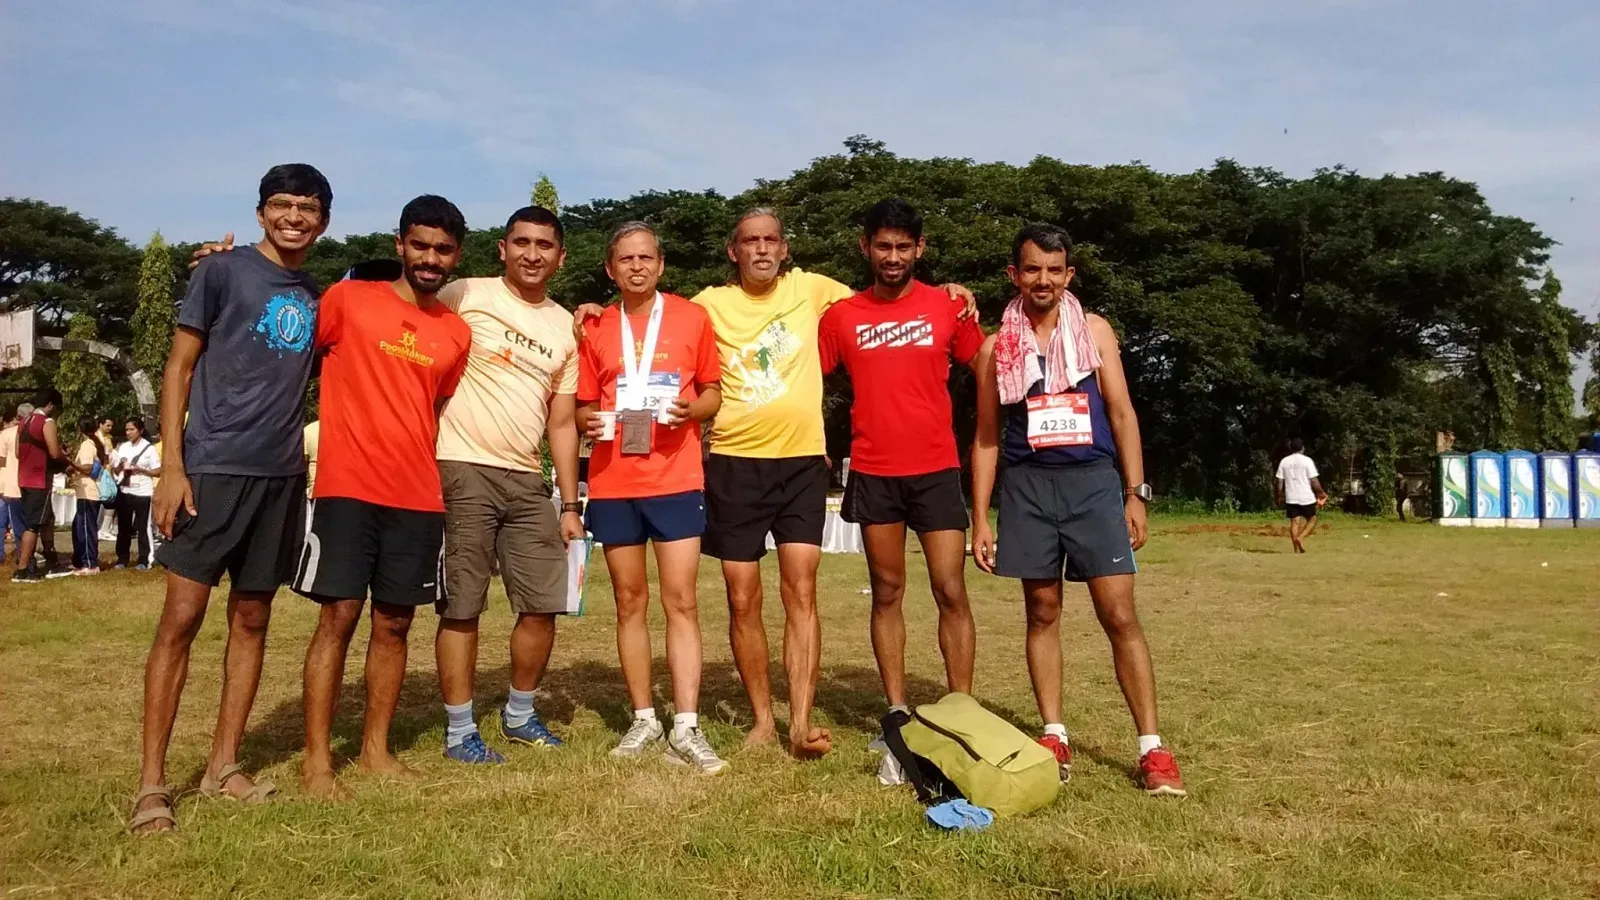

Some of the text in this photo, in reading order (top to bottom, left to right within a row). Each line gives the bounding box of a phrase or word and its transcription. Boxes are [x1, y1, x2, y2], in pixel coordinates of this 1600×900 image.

[504, 330, 553, 359] CREW
[859, 325, 930, 345] FINISHER
[1040, 418, 1077, 431] 4238
